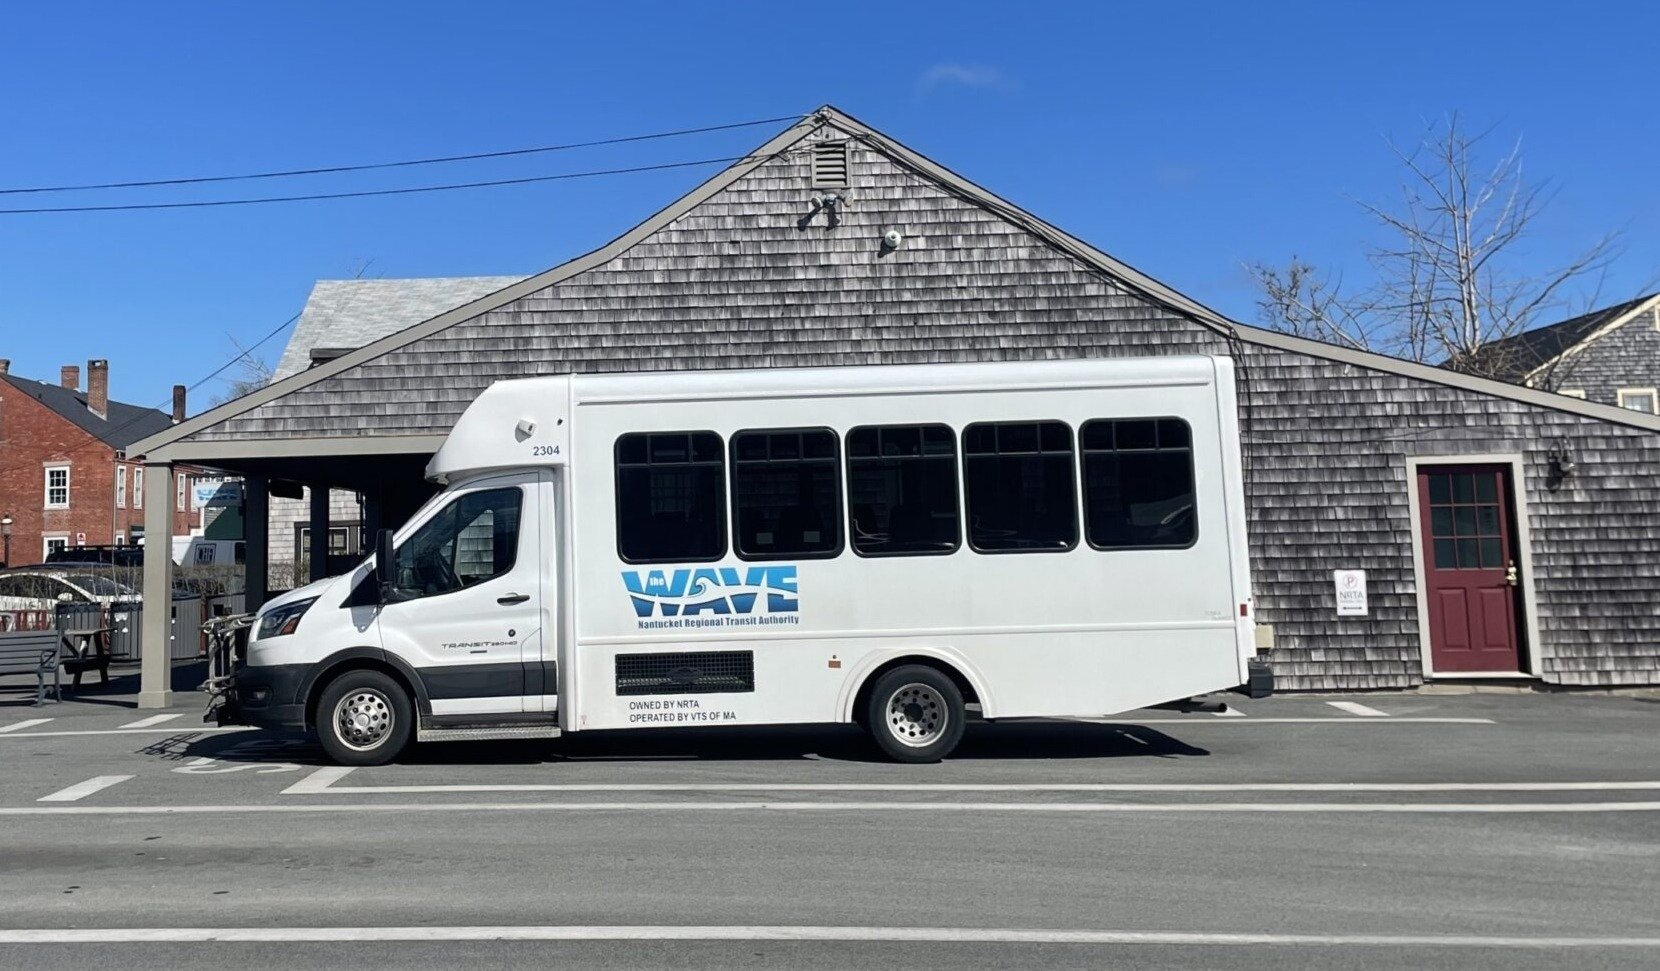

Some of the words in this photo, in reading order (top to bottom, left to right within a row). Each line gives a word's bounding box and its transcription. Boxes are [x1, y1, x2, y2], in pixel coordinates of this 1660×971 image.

[533, 445, 560, 456] 2304
[650, 576, 664, 586] the
[621, 566, 799, 617] WAVE
[1339, 591, 1364, 599] NRTA
[638, 618, 683, 629] Nantucket
[685, 617, 723, 628] Regional
[726, 616, 757, 626] Transit
[758, 615, 800, 626] Authority
[629, 701, 661, 710] OWNED
[663, 701, 674, 709] BY
[677, 700, 700, 709] NRTA
[629, 713, 675, 723] OPERATED
[677, 713, 689, 722] BY
[691, 712, 707, 721] VTS
[709, 711, 720, 720] OF
[723, 711, 736, 720] MA
